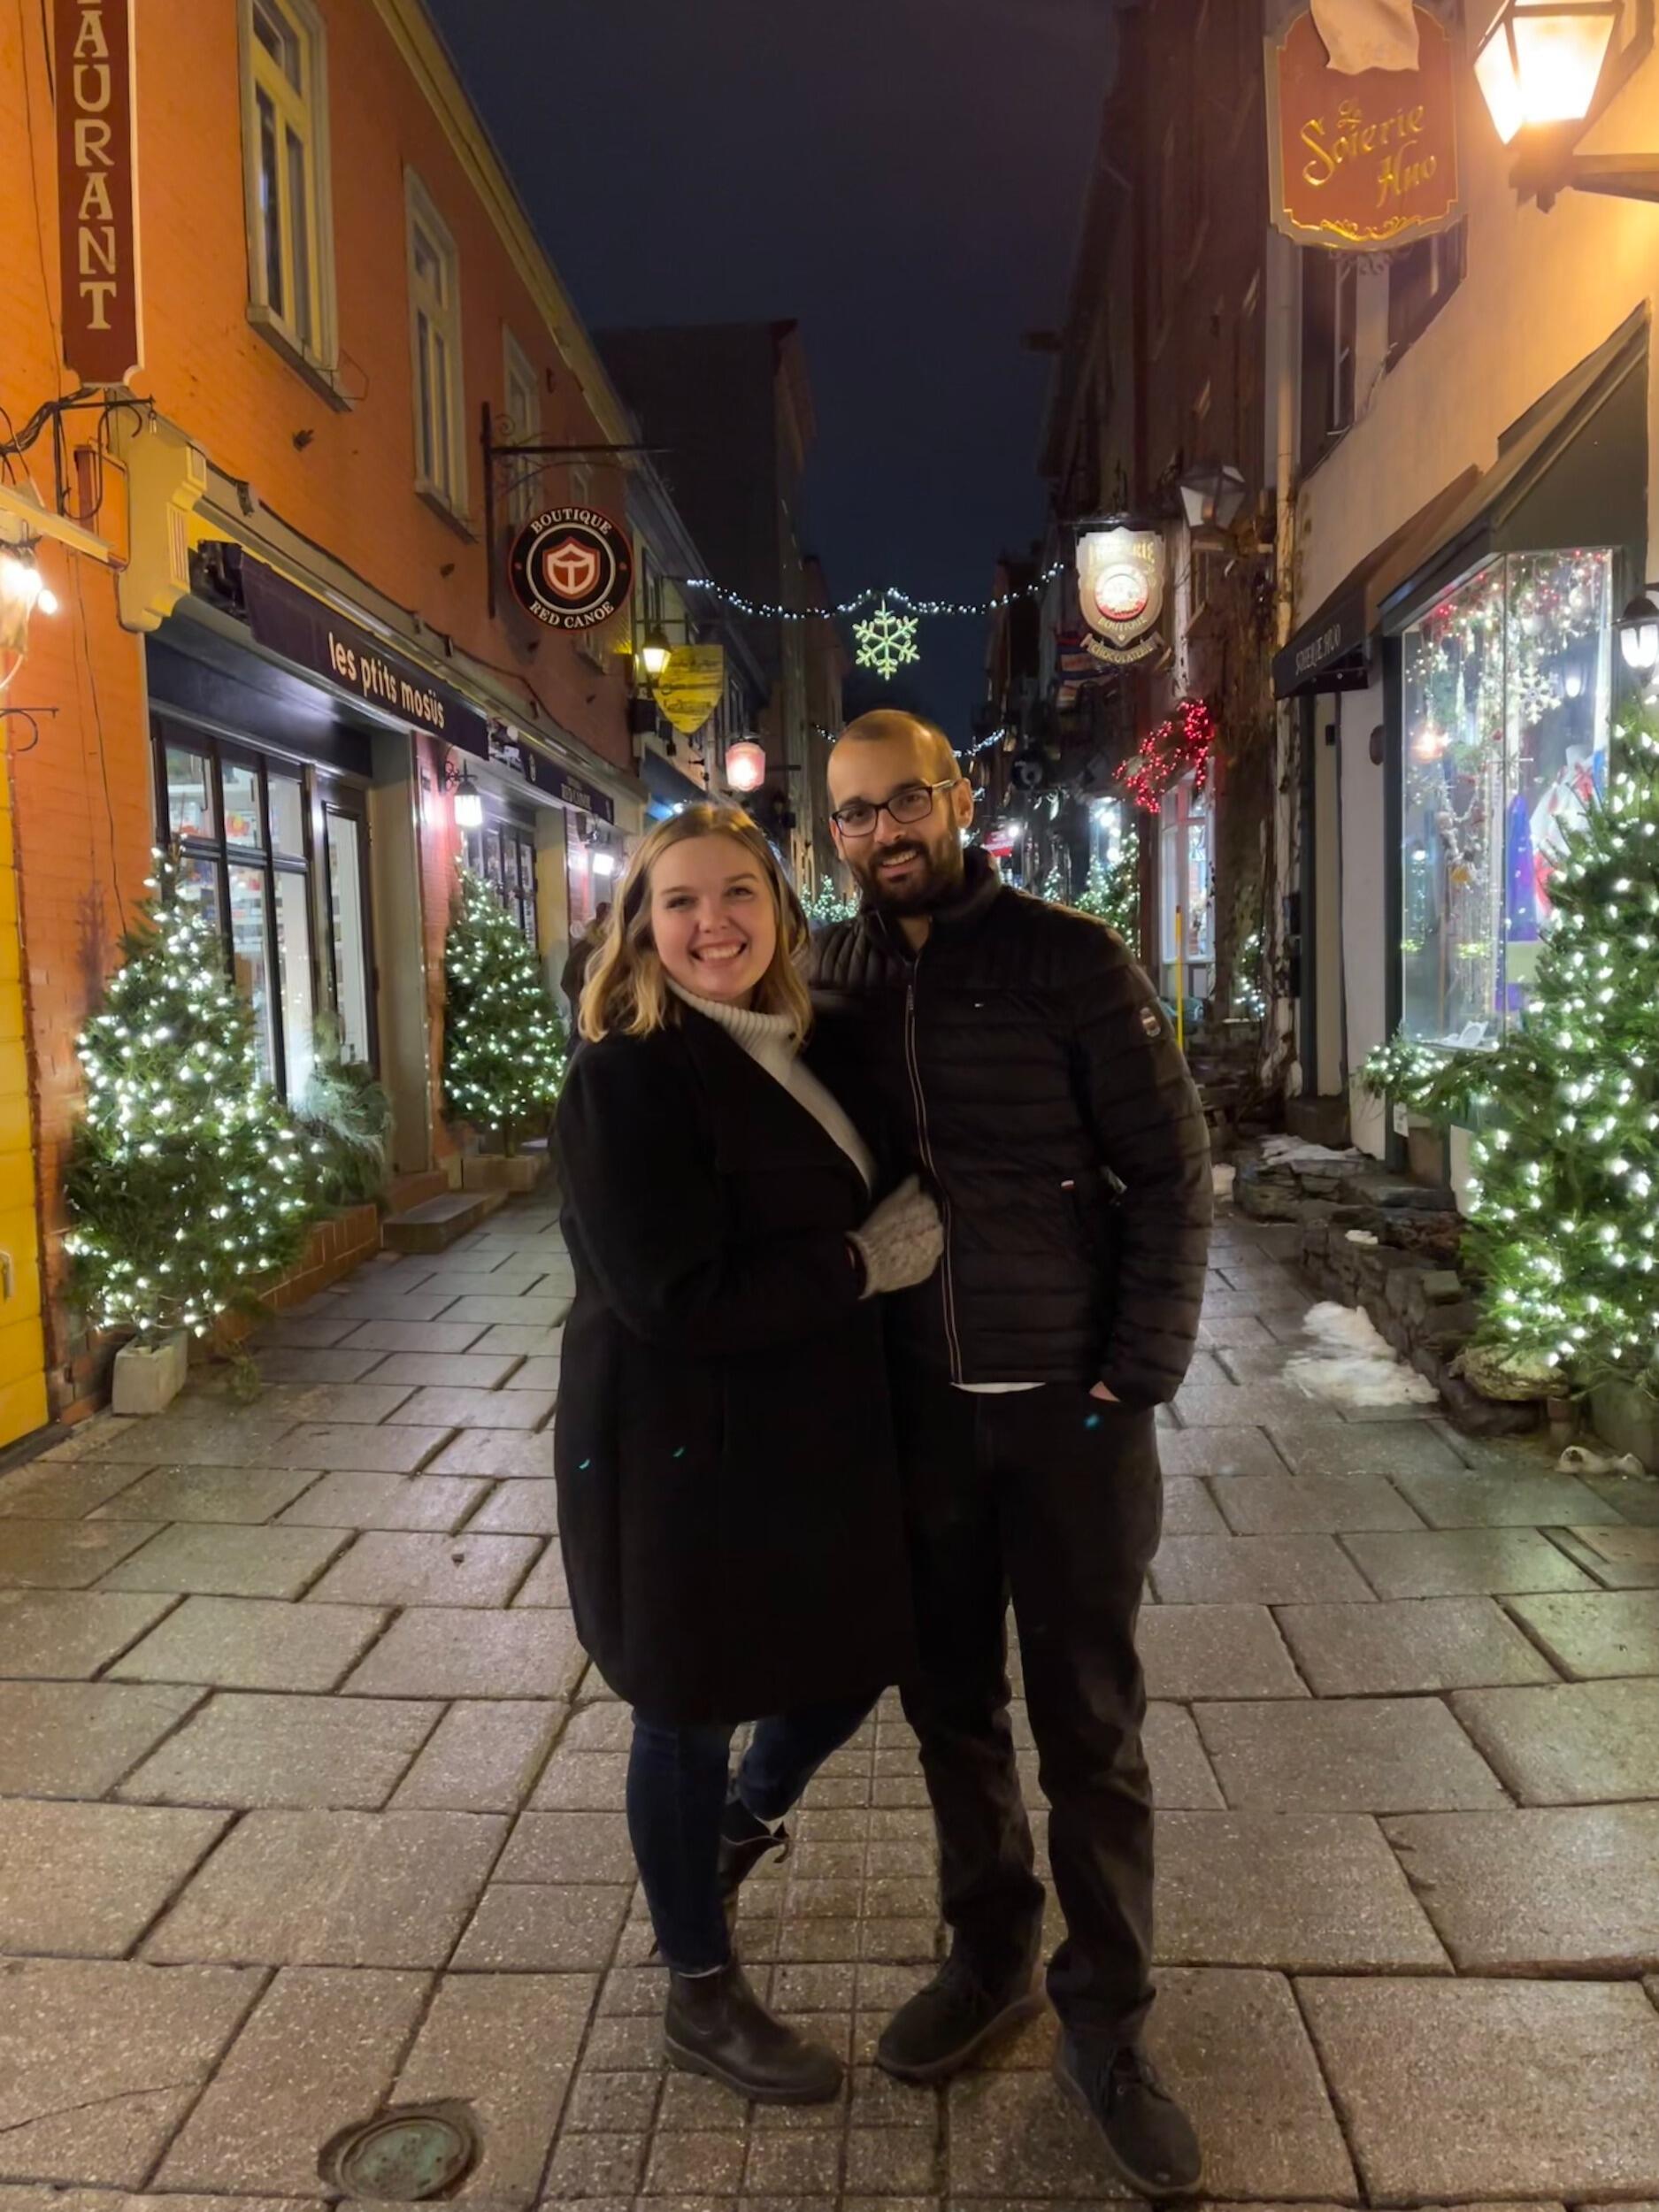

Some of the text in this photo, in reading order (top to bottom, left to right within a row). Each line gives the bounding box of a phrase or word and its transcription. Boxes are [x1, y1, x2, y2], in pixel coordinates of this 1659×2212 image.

[73, 0, 117, 330] AURANT
[531, 508, 612, 534] BOUTIQUE
[529, 600, 614, 628] RED CANOE
[328, 631, 445, 730] les ptits mosüs
